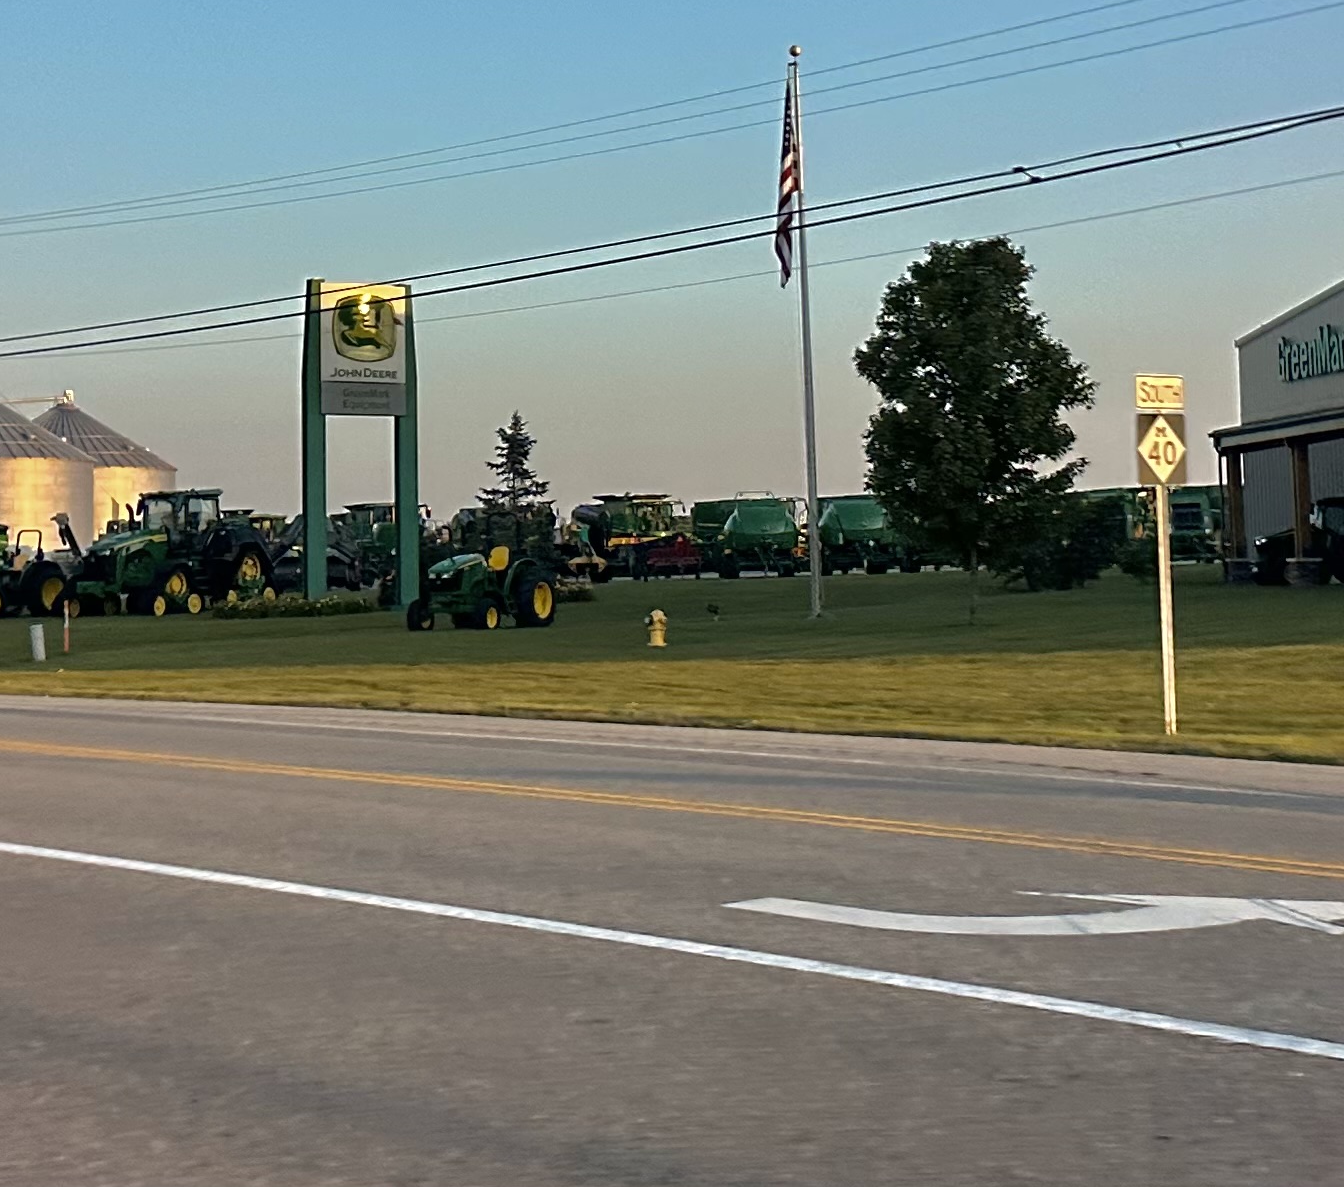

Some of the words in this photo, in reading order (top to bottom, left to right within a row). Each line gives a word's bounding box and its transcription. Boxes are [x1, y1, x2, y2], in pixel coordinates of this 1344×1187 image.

[330, 367, 362, 378] JOHN
[363, 367, 398, 379] DEERE
[1148, 440, 1177, 466] 40
